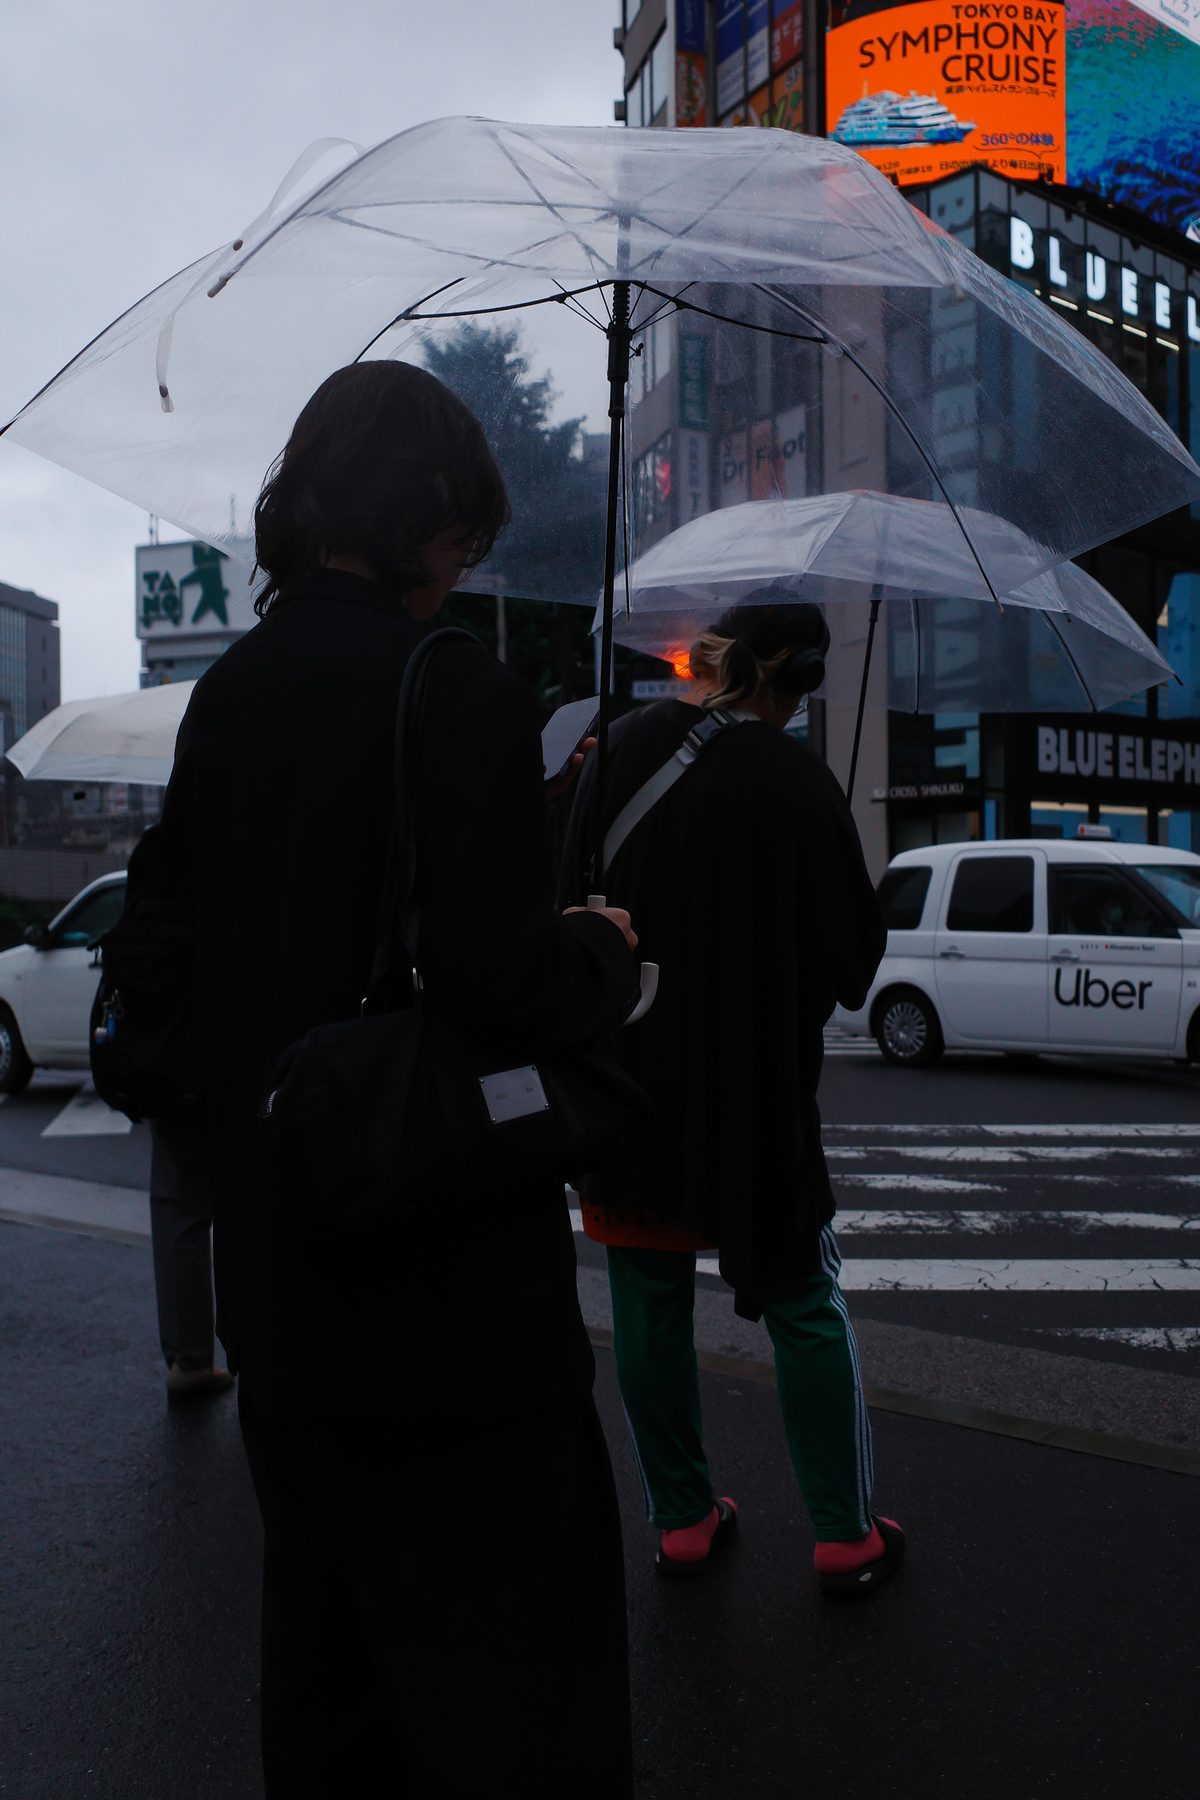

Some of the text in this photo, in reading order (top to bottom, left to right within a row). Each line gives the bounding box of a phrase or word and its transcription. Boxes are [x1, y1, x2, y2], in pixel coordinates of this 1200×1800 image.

[952, 4, 1058, 23] TOKYO BAY
[859, 21, 1058, 68] SYMPHONY
[941, 53, 1057, 87] CRUISE
[1037, 725, 1200, 784] BLUE ELEPH
[1054, 966, 1152, 1010] Uber
